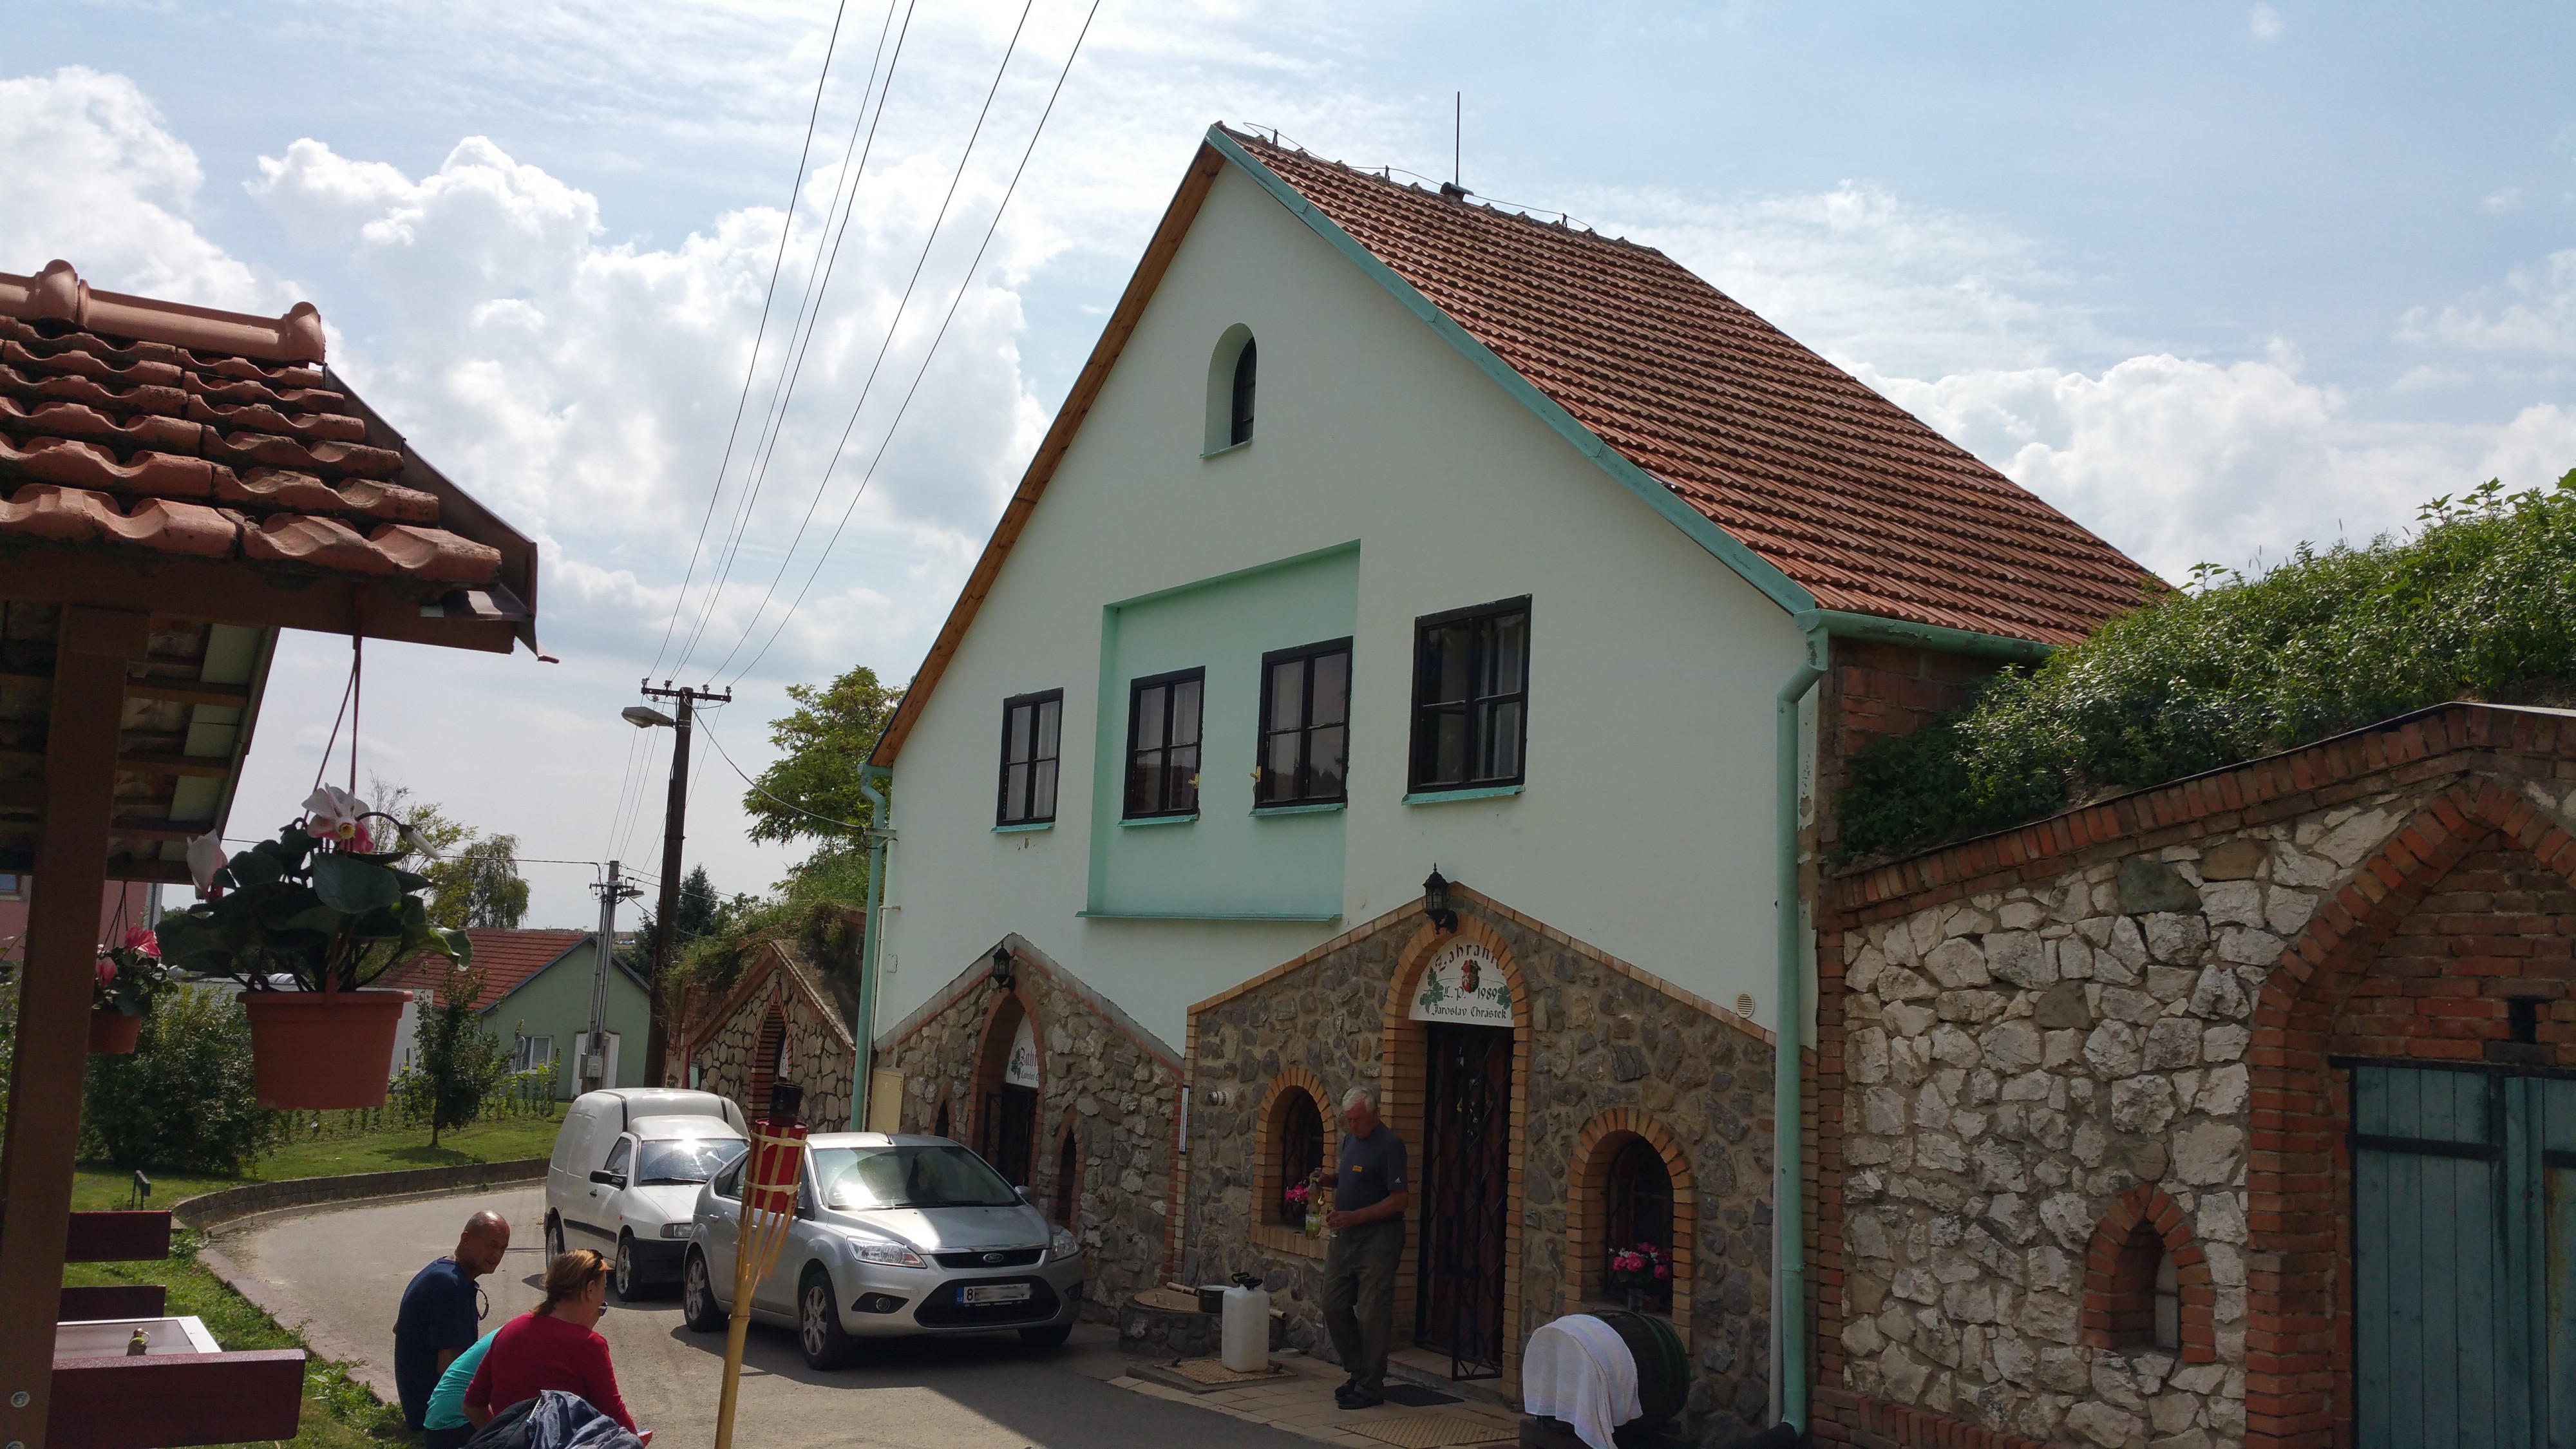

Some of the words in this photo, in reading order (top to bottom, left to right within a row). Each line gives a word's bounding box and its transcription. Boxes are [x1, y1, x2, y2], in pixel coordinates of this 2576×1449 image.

[1443, 985, 1454, 998] L.
[1477, 987, 1498, 1000] 1989
[1431, 1003, 1467, 1017] Jaroslav
[1470, 1005, 1507, 1019] Chrástek
